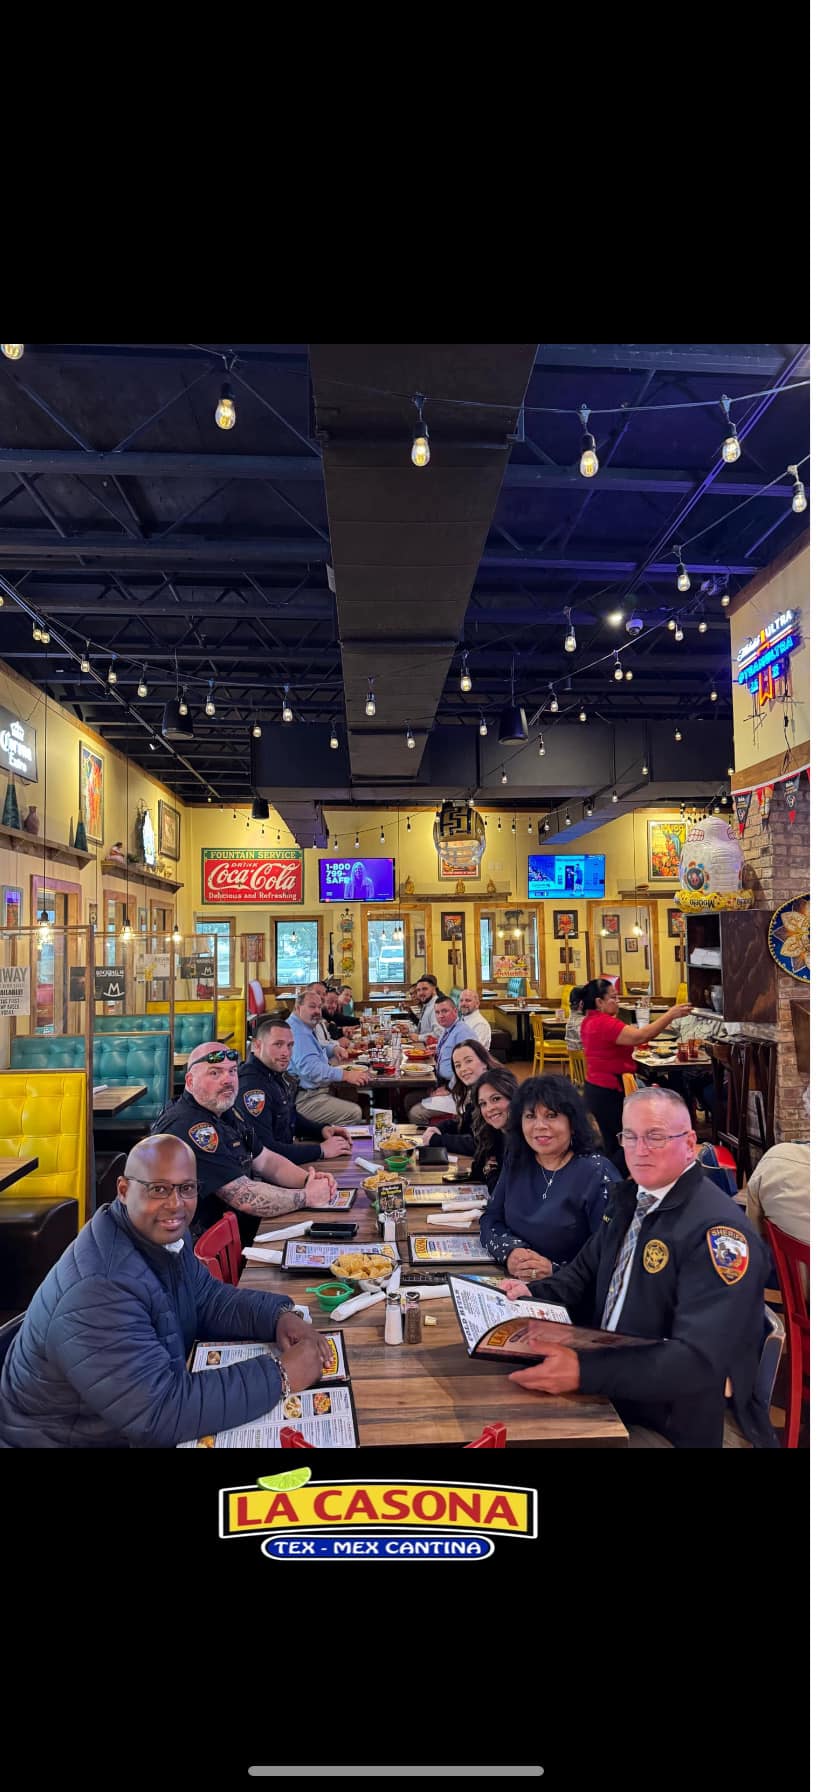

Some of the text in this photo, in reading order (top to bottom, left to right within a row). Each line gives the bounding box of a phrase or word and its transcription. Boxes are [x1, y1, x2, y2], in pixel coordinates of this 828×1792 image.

[764, 609, 793, 636] ULTRA
[210, 851, 296, 859] FOUNTAIN SERVICE
[326, 863, 351, 871] 1-800
[326, 870, 347, 878] 799-
[259, 891, 297, 901] Refreshing
